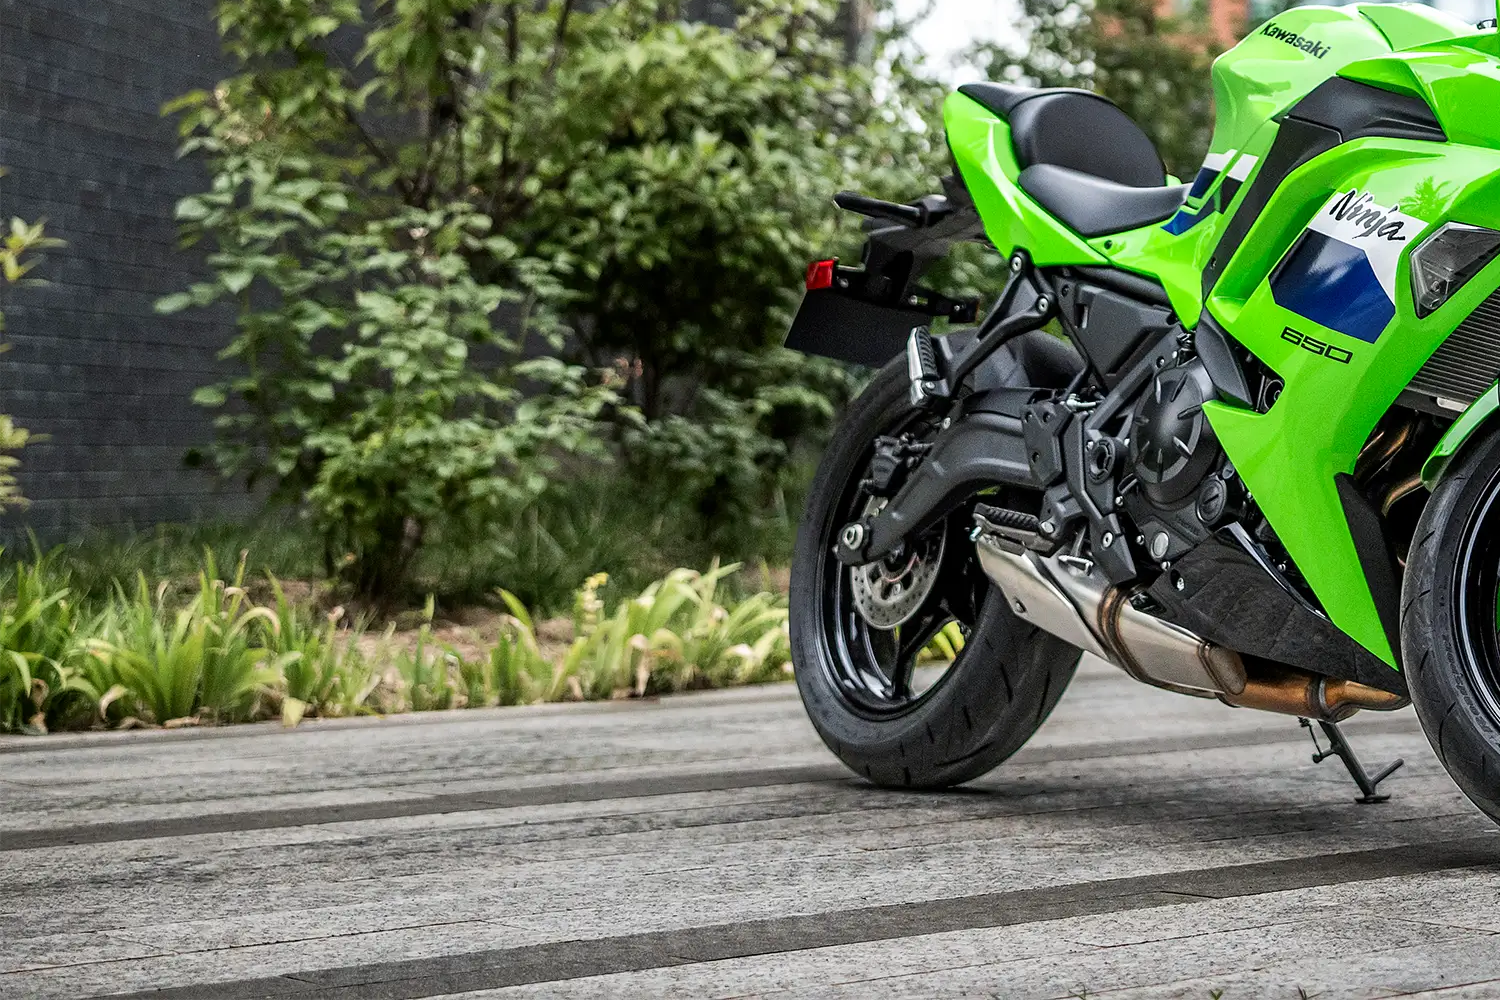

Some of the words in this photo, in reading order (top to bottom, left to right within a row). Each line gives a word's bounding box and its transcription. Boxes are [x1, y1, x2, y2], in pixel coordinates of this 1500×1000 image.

[1260, 22, 1331, 59] Kawasaki
[1329, 189, 1405, 241] Ninja
[1280, 326, 1353, 364] 650
